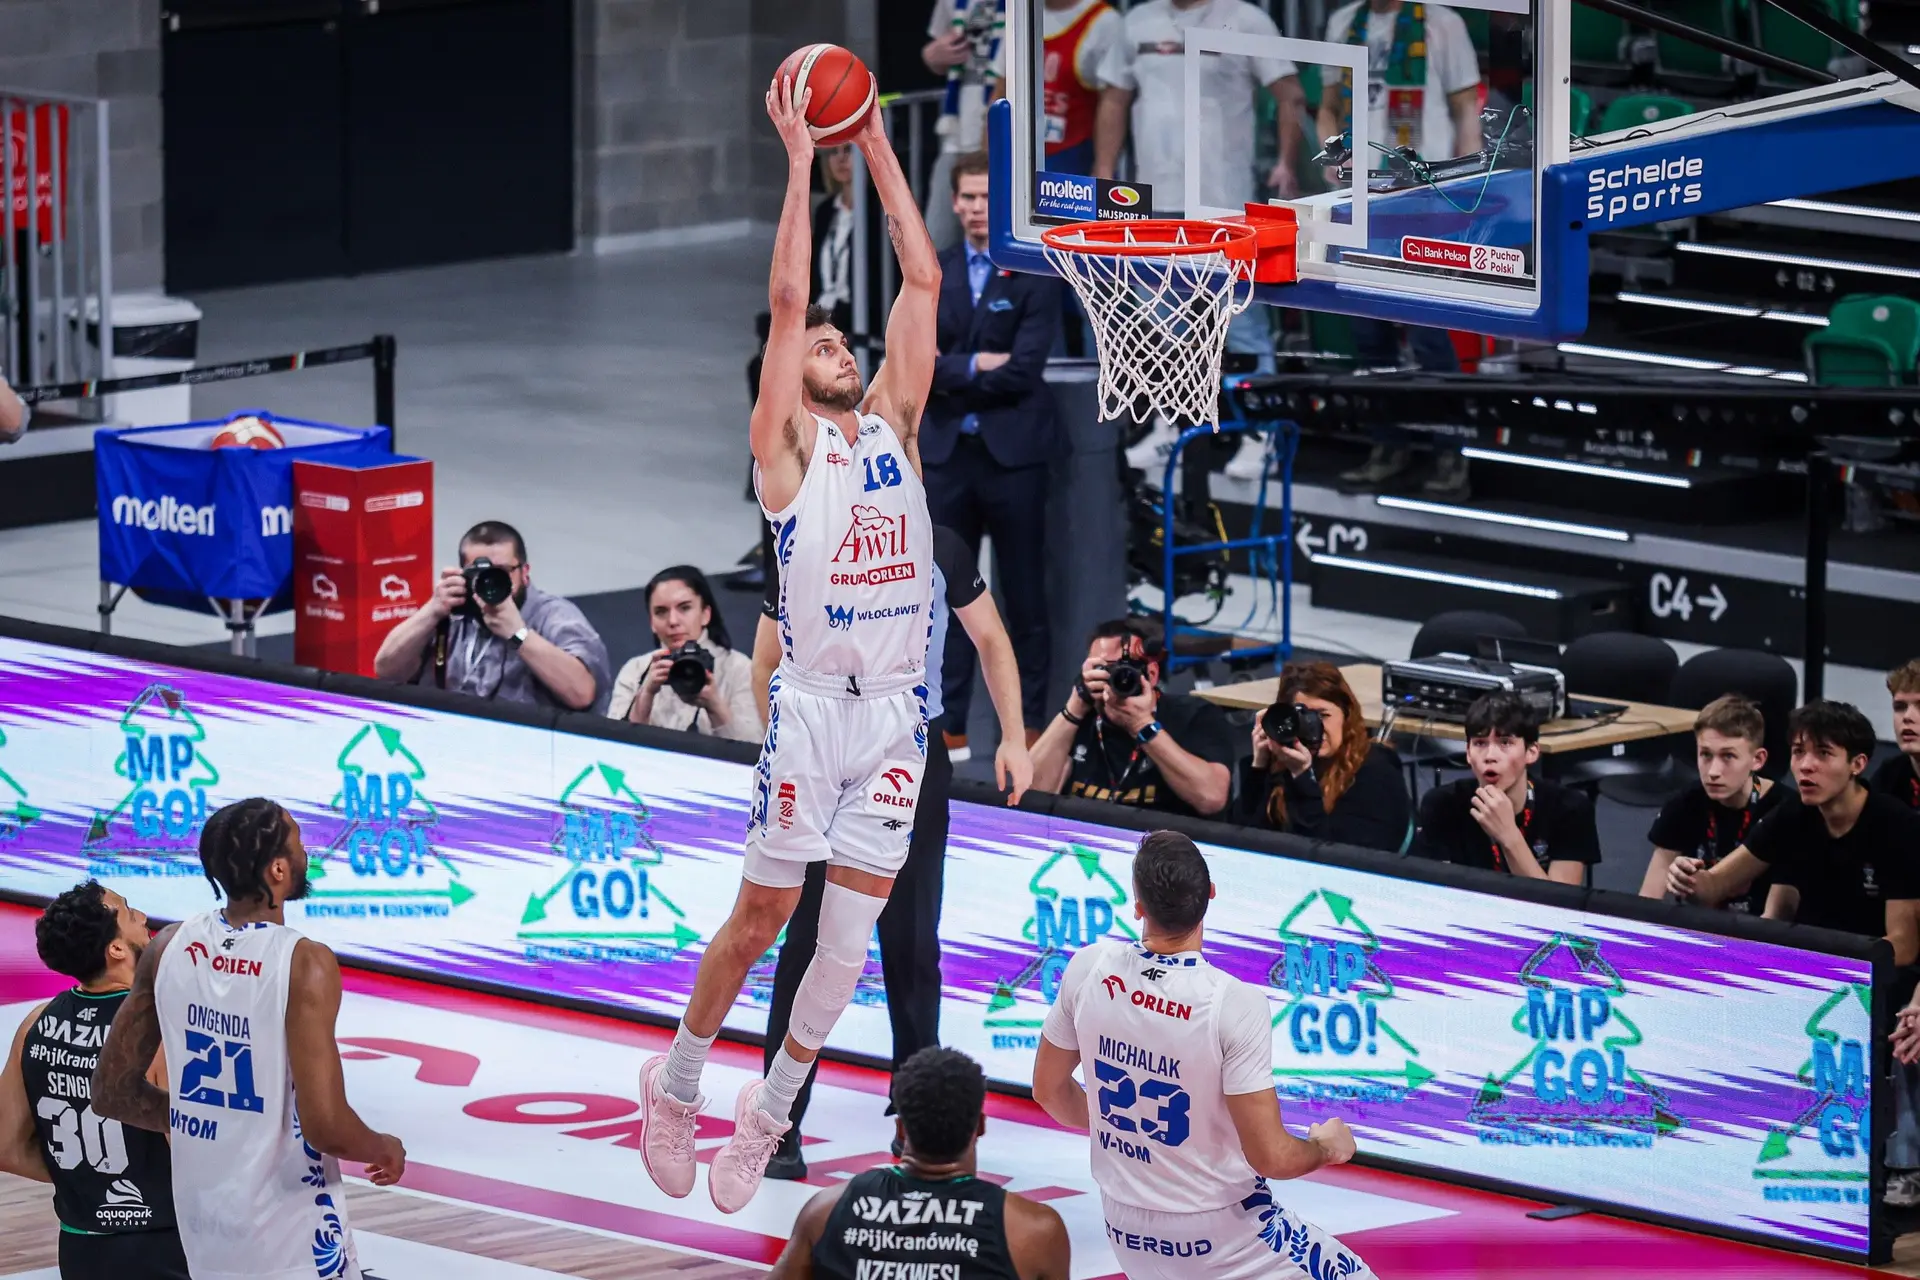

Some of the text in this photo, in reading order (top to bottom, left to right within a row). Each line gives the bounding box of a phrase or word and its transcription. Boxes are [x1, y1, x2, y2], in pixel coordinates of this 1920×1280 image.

[1040, 180, 1092, 202] molten
[1588, 156, 1703, 193] Schelde
[1039, 198, 1049, 207] For
[1050, 200, 1060, 208] the
[1074, 203, 1092, 213] game
[1587, 183, 1702, 222] Sports
[1424, 246, 1520, 263] Bank Pekao Puchar
[1490, 261, 1515, 275] Polski
[862, 452, 903, 493] 18
[111, 493, 216, 537] molten
[830, 513, 908, 563] Awil
[869, 564, 914, 583] ORLEN
[1649, 572, 1693, 621] C4
[127, 734, 194, 782] MP
[131, 788, 207, 839] GO!
[343, 770, 413, 820] MP
[873, 792, 914, 809] ORLEN
[348, 827, 425, 877] GO!
[563, 812, 636, 862] MP
[570, 868, 649, 920] GO!
[1035, 895, 1113, 949] MP
[1141, 967, 1167, 981] 4F
[1284, 942, 1366, 995] MP
[76, 1007, 99, 1021] 4F
[187, 1003, 251, 1040] ONGENDA
[1131, 990, 1192, 1021] ORLEN
[1526, 988, 1610, 1042] MP
[1290, 1002, 1378, 1056] GO!
[29, 1043, 99, 1070] #PijKranó
[179, 1029, 264, 1113] 21
[1099, 1034, 1181, 1080] MICHALAK
[1532, 1048, 1627, 1104] GO!
[1811, 1039, 1870, 1098] M
[171, 1107, 218, 1141] WTOM
[1094, 1058, 1191, 1148] 23
[36, 1096, 129, 1175] 30
[1096, 1128, 1152, 1164] W-TOM
[95, 1208, 153, 1222] aquapark
[852, 1196, 984, 1226] BAZALT
[843, 1227, 980, 1258] #PijKranówkę
